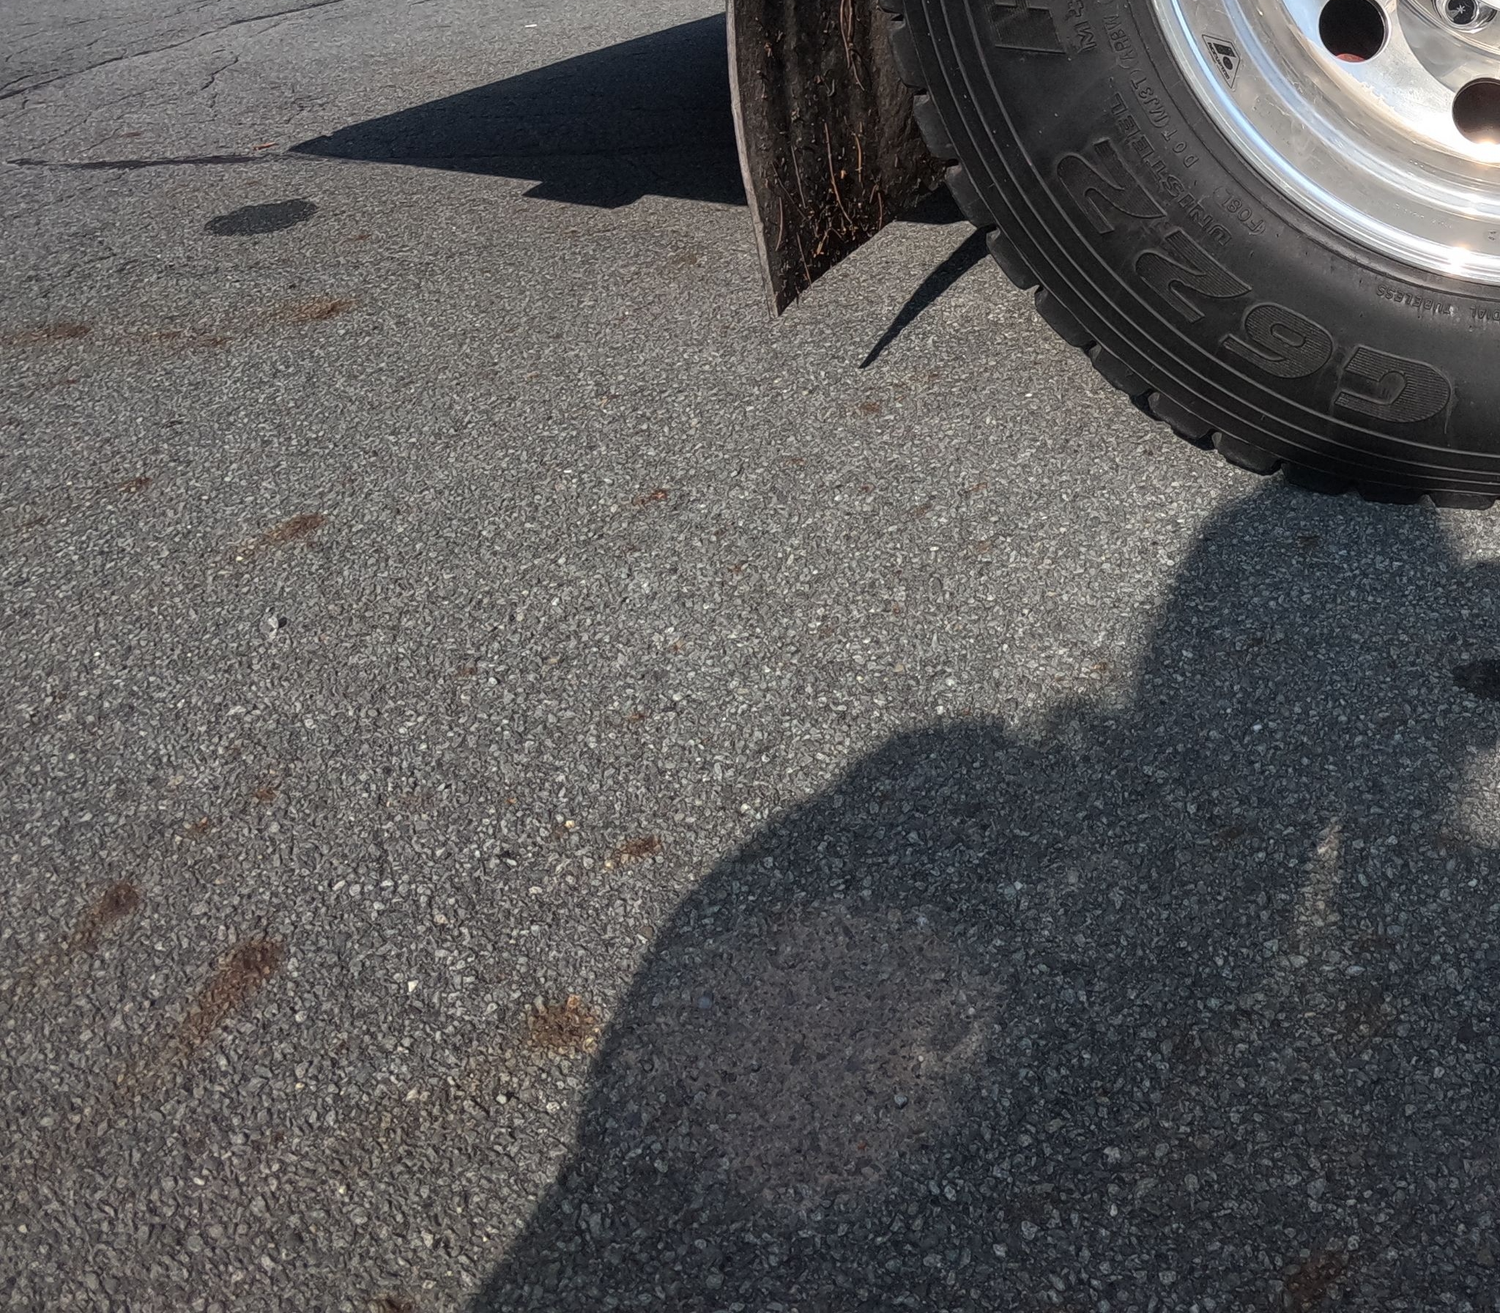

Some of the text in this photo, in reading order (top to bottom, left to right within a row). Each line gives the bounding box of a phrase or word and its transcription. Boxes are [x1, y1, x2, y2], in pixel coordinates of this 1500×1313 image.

[1105, 90, 1233, 248] UNISTEEL
[1055, 137, 1452, 426] G622
[1373, 280, 1452, 318] TUBELESS
